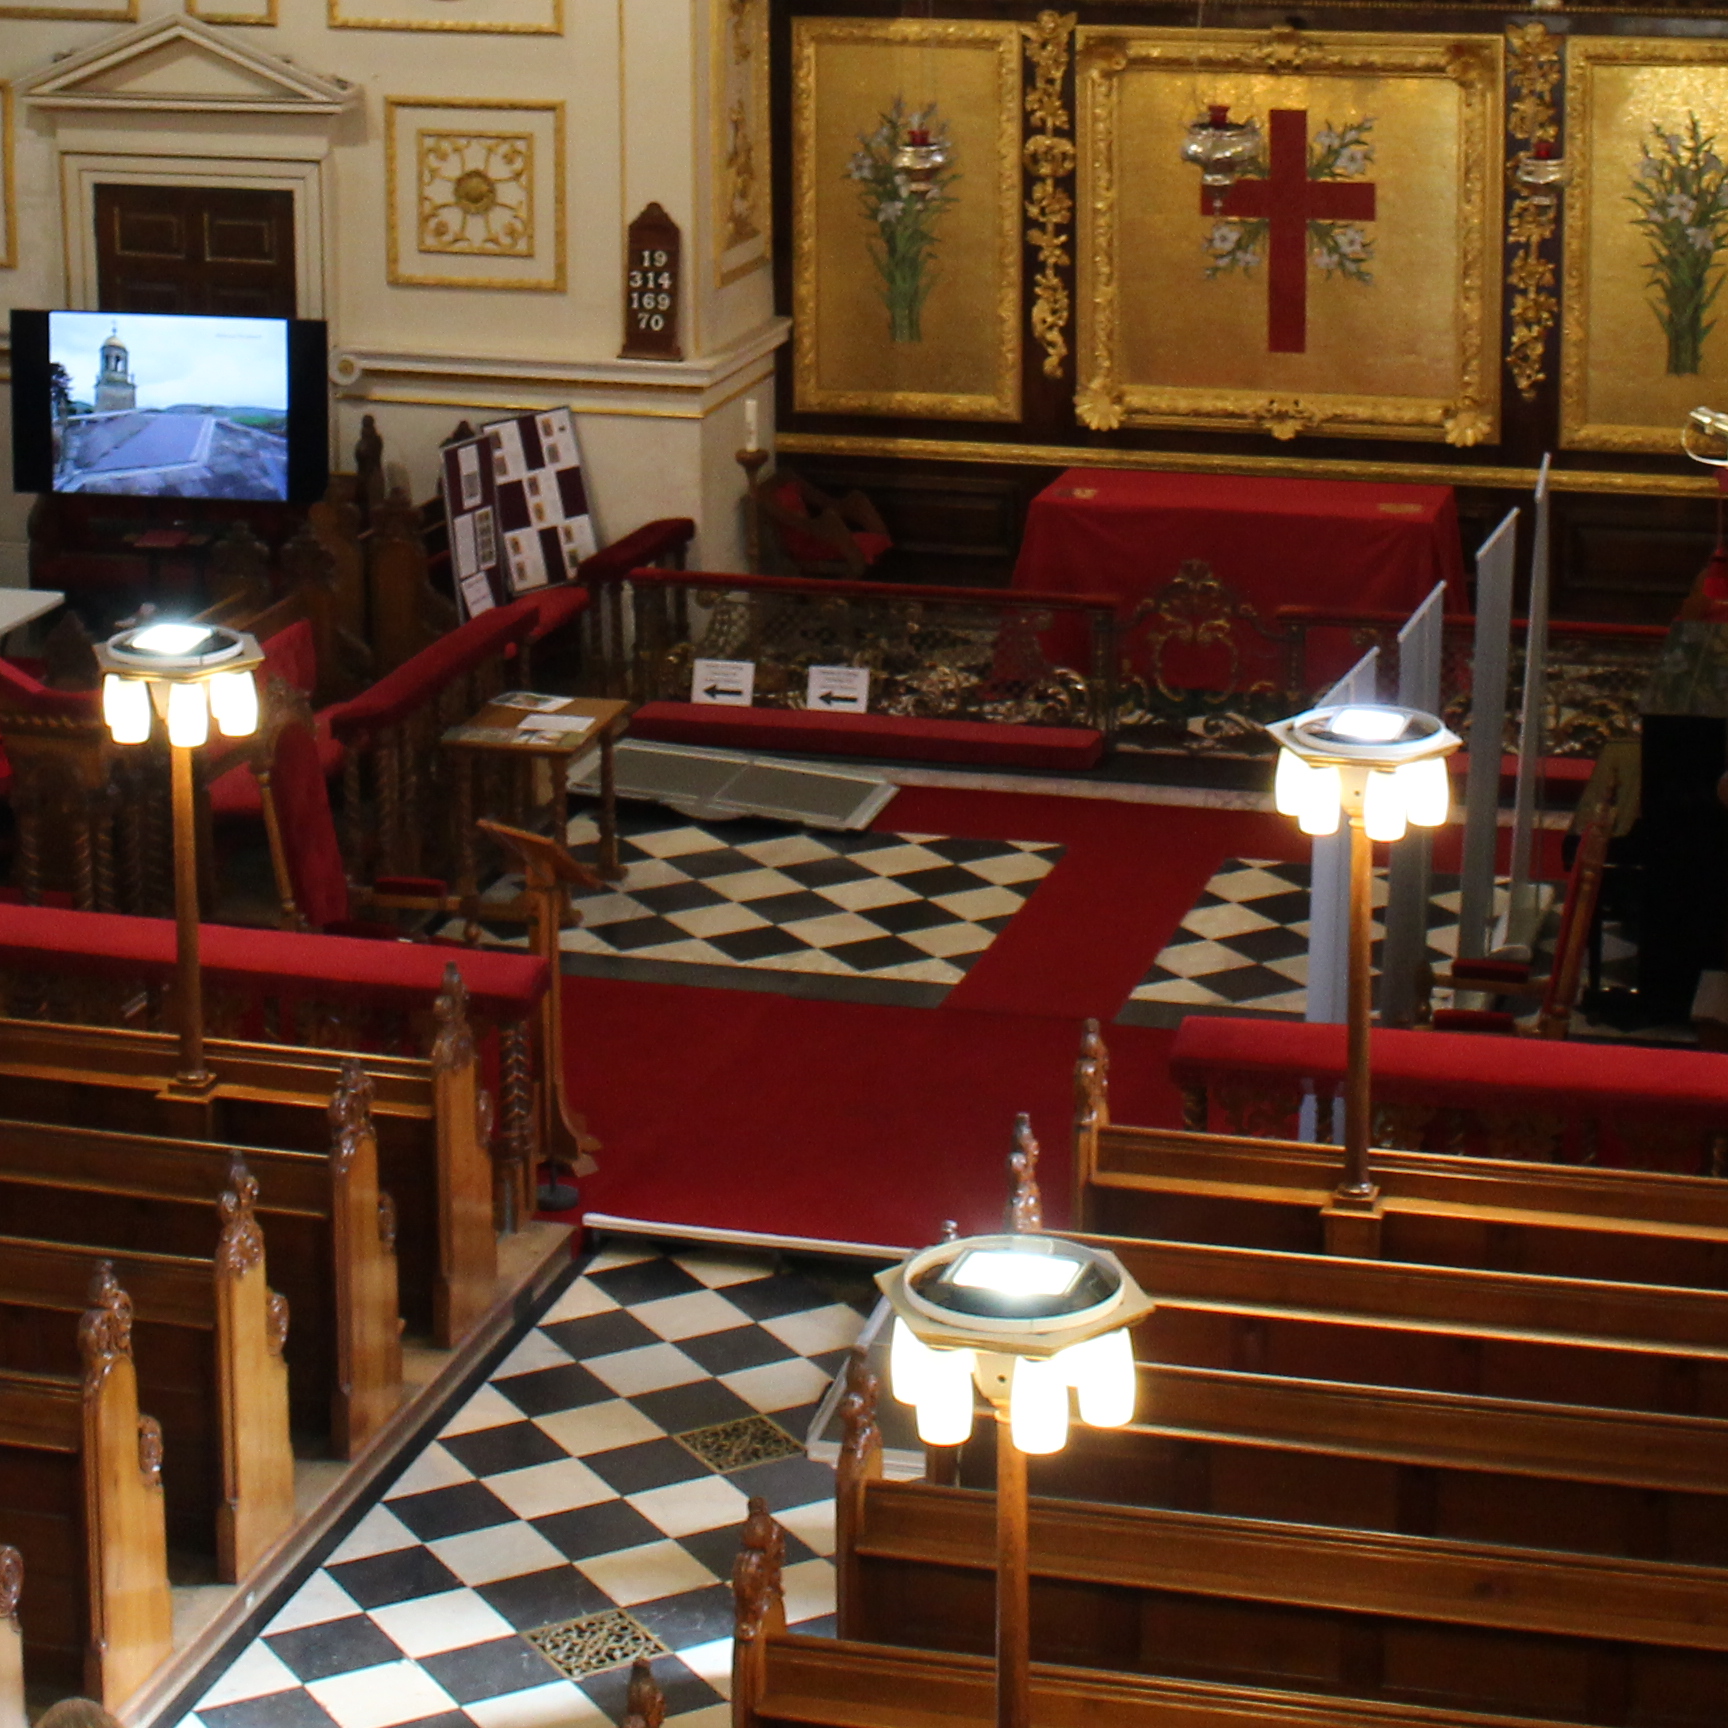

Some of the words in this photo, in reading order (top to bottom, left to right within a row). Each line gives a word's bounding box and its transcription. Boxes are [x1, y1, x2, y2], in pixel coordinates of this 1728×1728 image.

[642, 250, 667, 267] 19
[630, 270, 671, 289] 314
[632, 292, 670, 310] 169
[638, 313, 664, 331] 70
